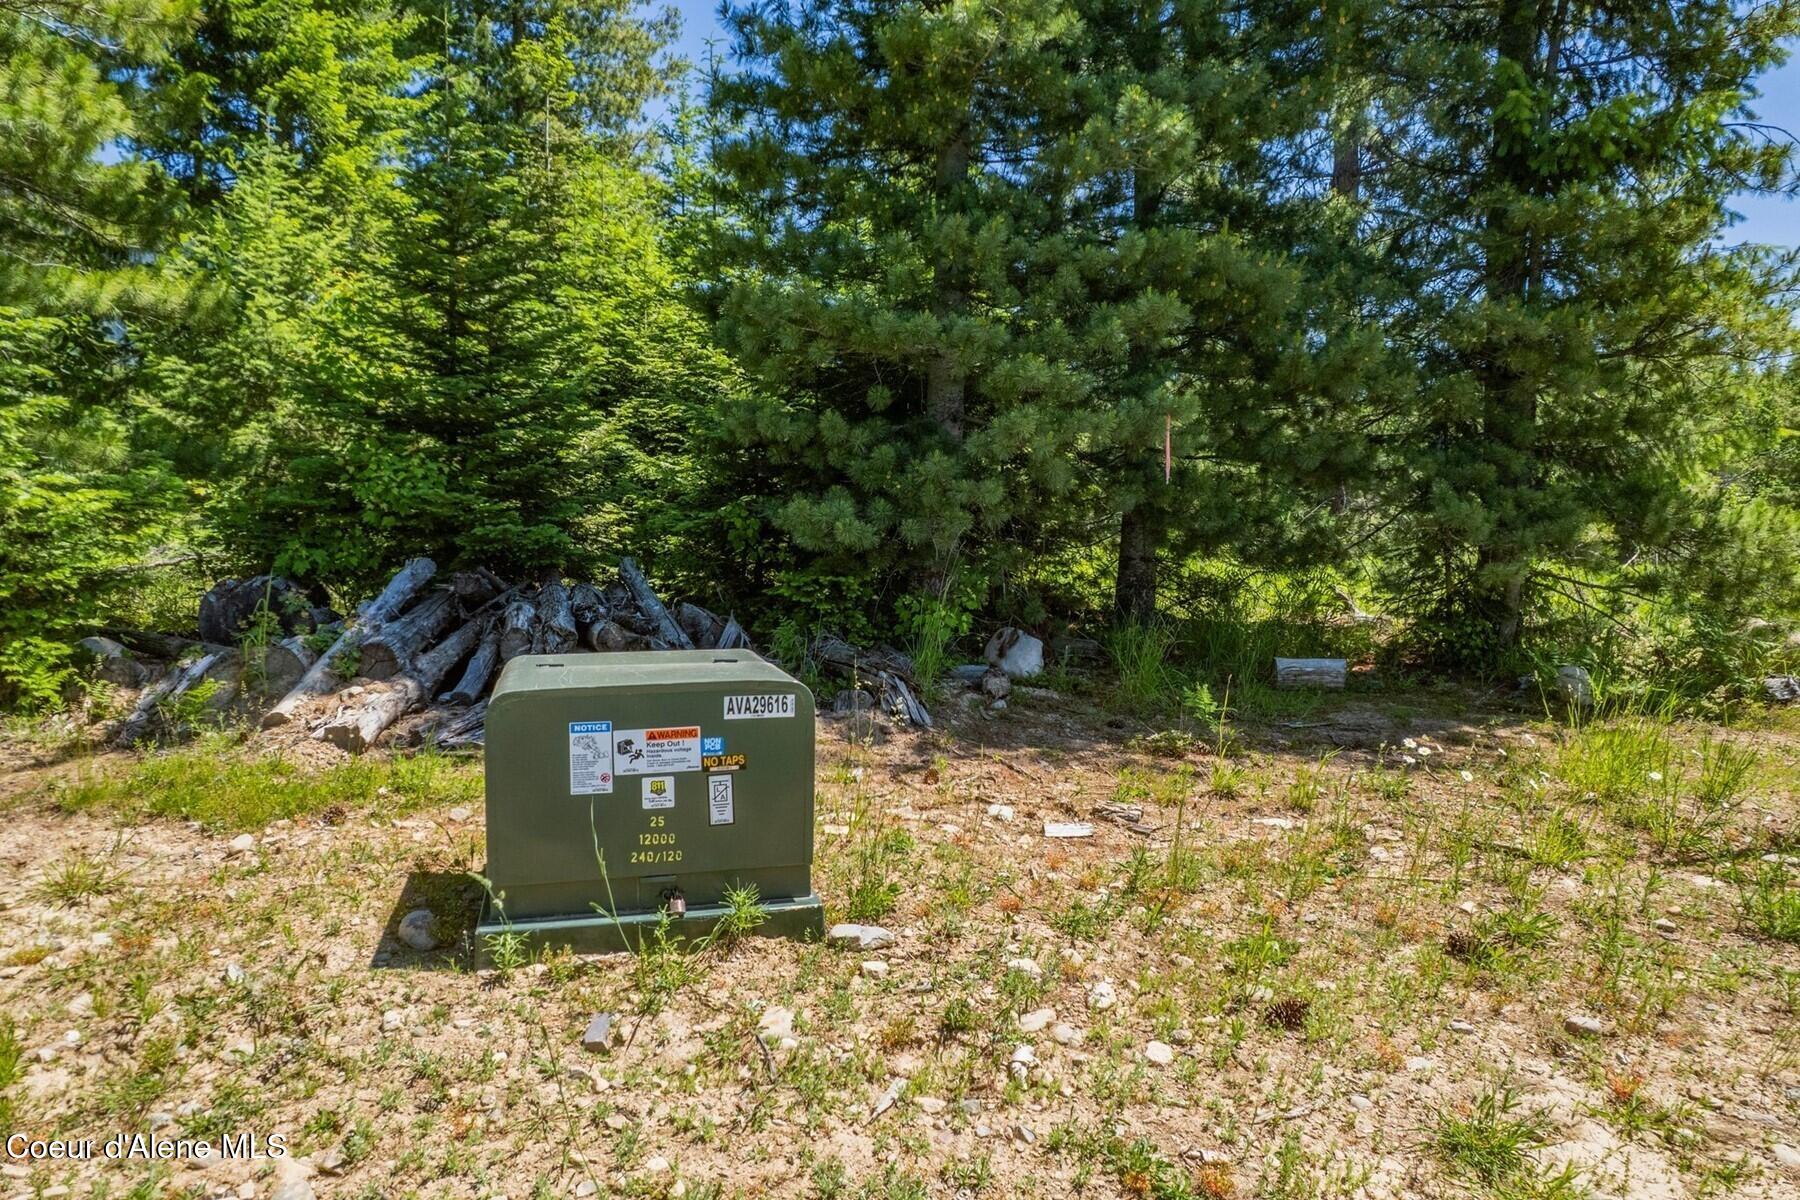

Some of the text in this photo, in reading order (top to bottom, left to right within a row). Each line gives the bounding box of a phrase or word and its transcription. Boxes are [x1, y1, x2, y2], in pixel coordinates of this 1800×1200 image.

[727, 696, 788, 714] AVA29616
[657, 729, 697, 738] WARNING
[704, 755, 745, 767] NO TAPS
[651, 781, 665, 791] 811
[650, 816, 665, 827] 25
[639, 833, 675, 845] 12000
[631, 850, 683, 863] 240/120
